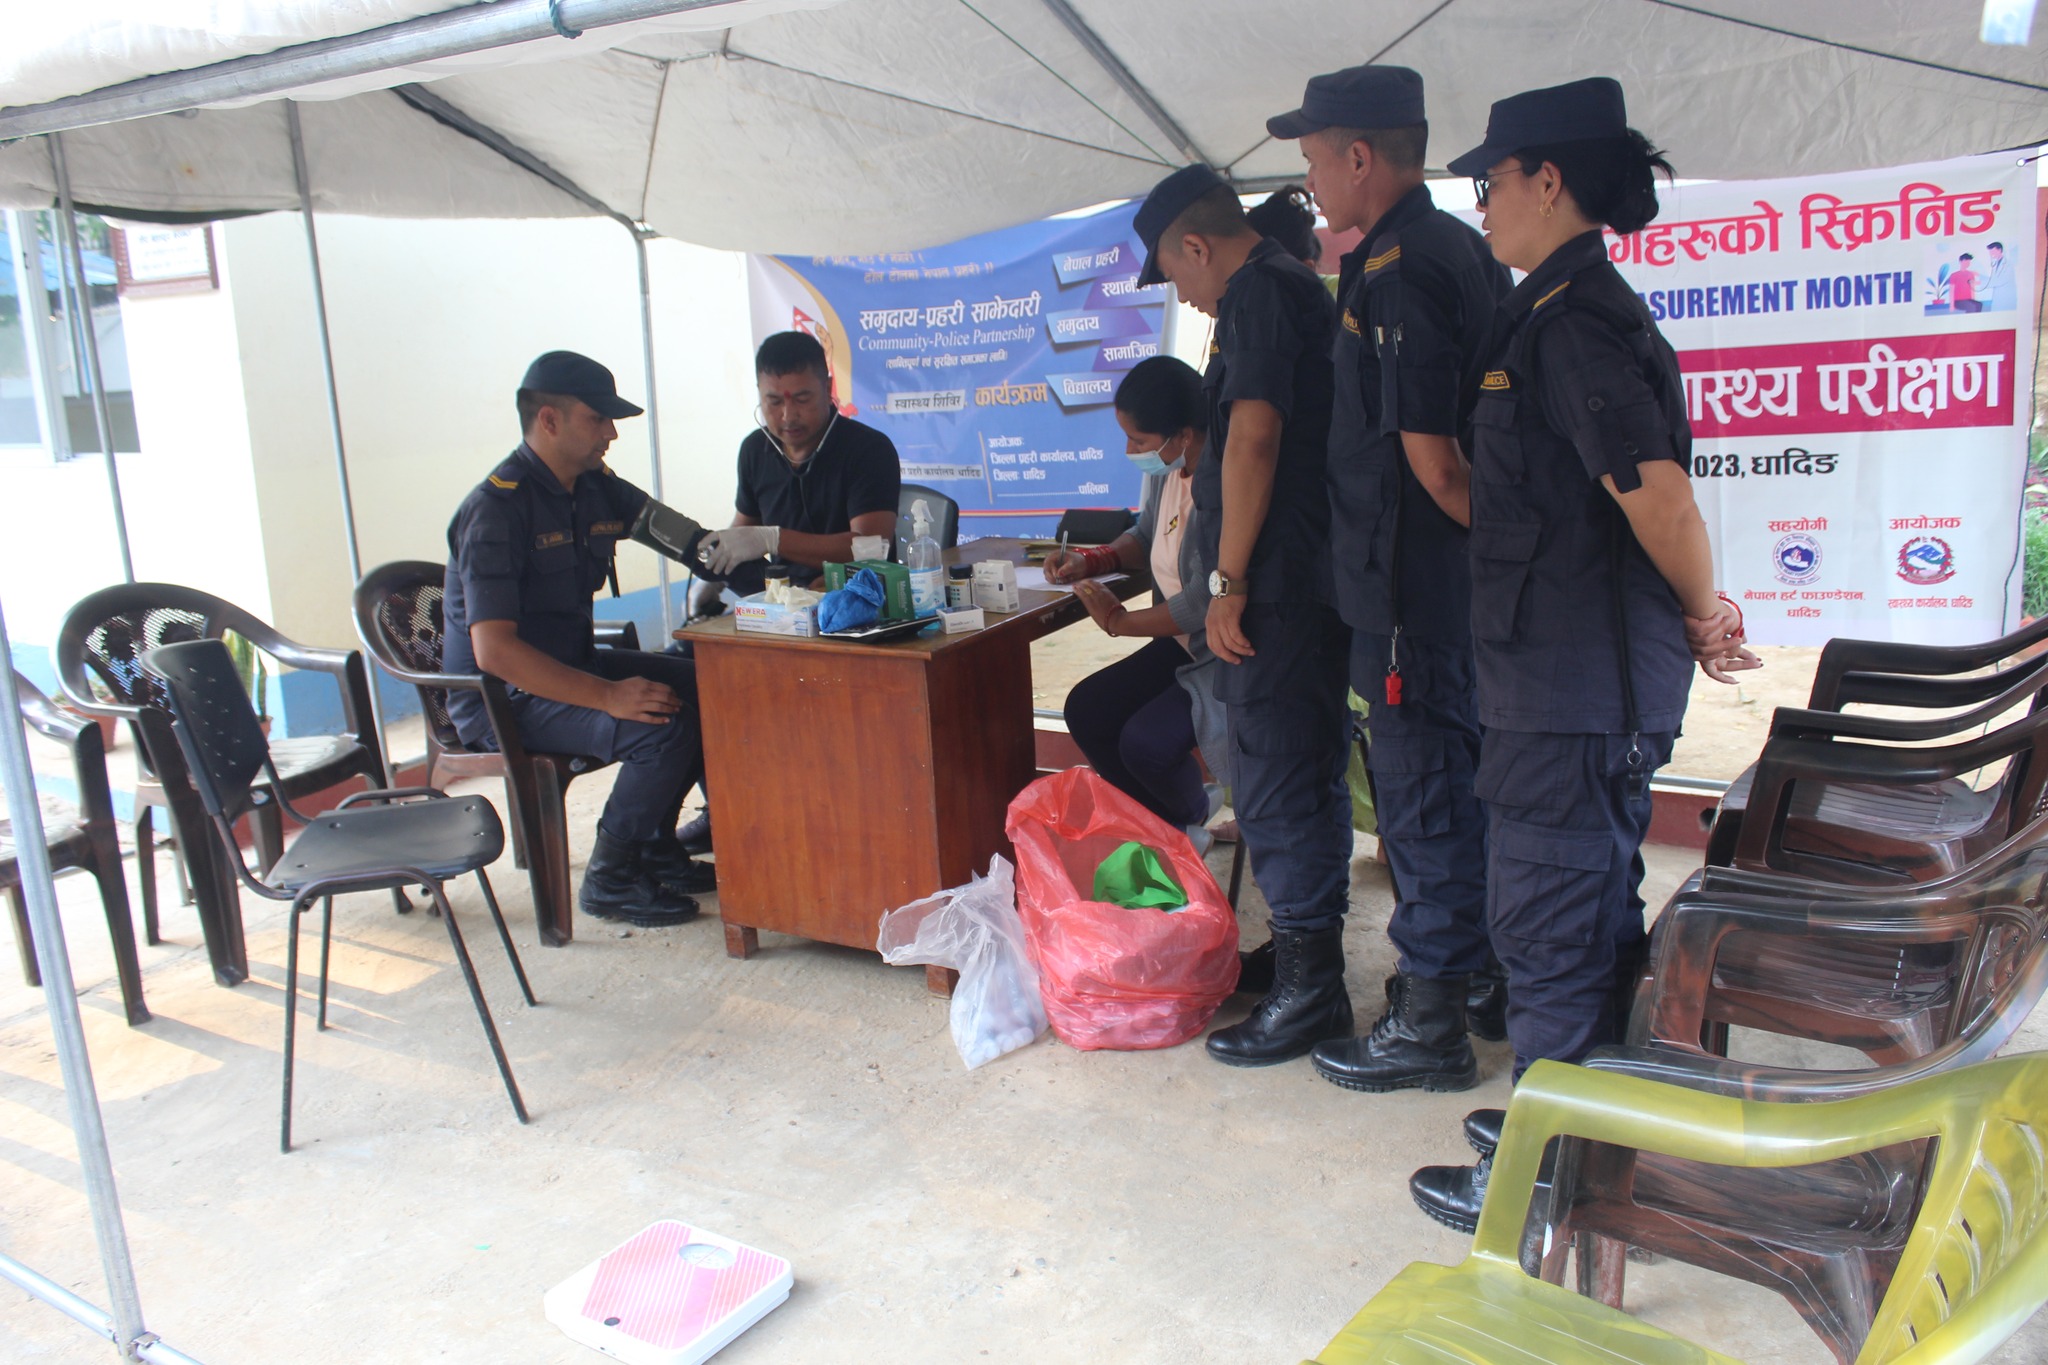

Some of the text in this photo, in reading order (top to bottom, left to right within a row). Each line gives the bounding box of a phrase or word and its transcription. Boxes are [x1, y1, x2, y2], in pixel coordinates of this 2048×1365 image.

[1602, 183, 2003, 266] गहरूको स्क्रिनिङ
[1063, 246, 1120, 272] नेपाल प्रहरी
[1807, 271, 1912, 309] MONTH
[859, 299, 965, 334] समुदाय-प्रहरी
[1056, 316, 1100, 335] समुदाय
[858, 323, 1035, 351] Community-Police Partnership
[1103, 340, 1158, 363] सामाजिक
[895, 380, 1048, 409] स्वास्थ्य शिविर कार्यक्रम
[1063, 378, 1112, 395] विद्यालय
[1681, 343, 2005, 424] ास्थ्य परीक्षण
[991, 451, 1016, 465] जिल्ला
[1019, 450, 1038, 465] प्रहरी
[1079, 446, 1104, 460] धादिङ
[1751, 447, 1839, 476] धादिङ
[1768, 517, 1828, 533] सहयोगी
[1889, 515, 1962, 531] आयोजक
[1744, 589, 1777, 601] नेपाल
[736, 606, 766, 616] NEW ERA
[1787, 607, 1822, 618] धादिङ
